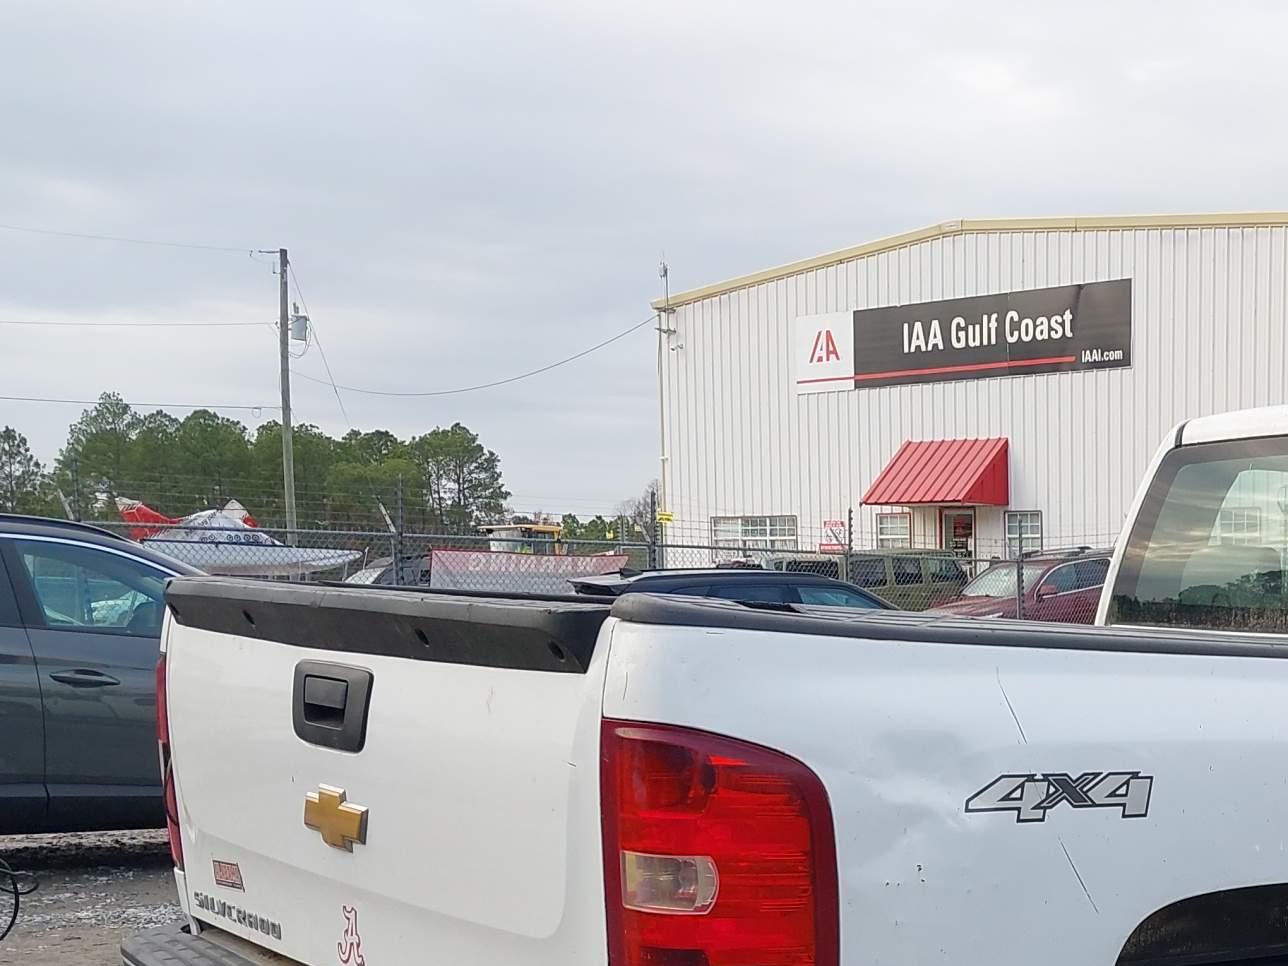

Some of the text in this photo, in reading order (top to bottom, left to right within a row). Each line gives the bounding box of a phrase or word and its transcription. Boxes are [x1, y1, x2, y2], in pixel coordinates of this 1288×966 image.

[903, 308, 1073, 353] IAA Gulf Coast
